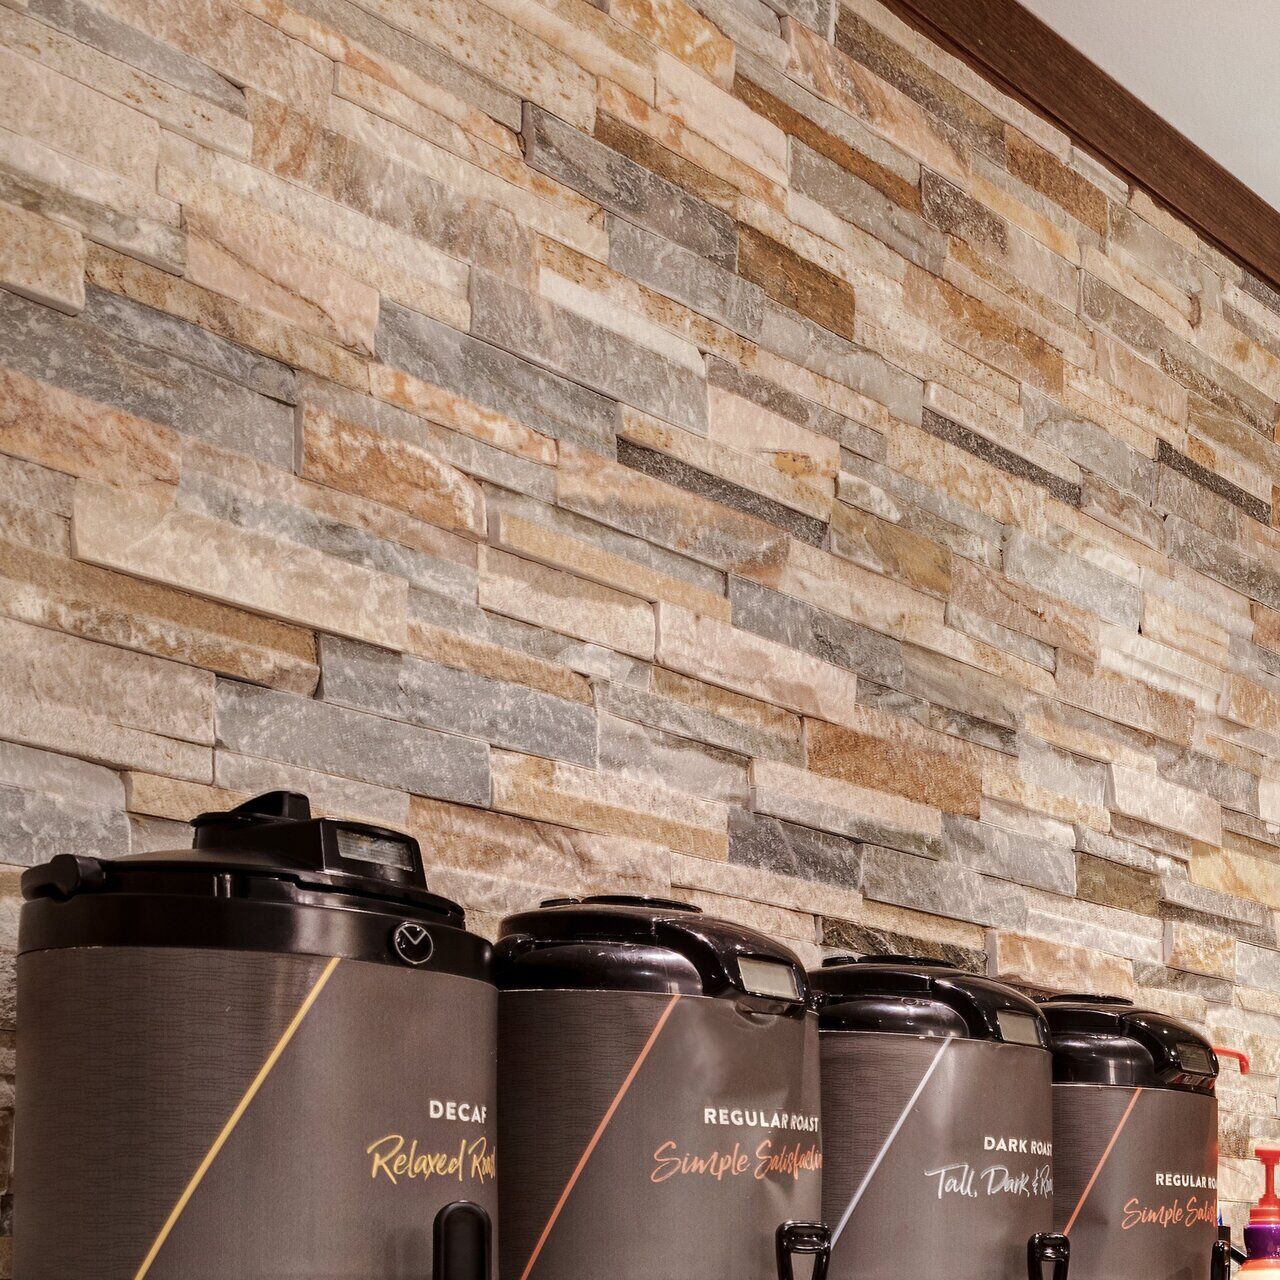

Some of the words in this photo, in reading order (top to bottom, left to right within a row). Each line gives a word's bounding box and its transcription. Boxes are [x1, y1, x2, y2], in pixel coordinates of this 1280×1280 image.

[429, 1100, 487, 1124] DECAF
[704, 1107, 789, 1130] REGULAR
[790, 1113, 819, 1132] ROAST
[366, 1134, 467, 1184] Relaxed
[984, 1136, 1028, 1154] DARK
[651, 1140, 750, 1183] Simple
[924, 1163, 978, 1199] Tall,
[980, 1165, 1030, 1198] Dark
[1155, 1173, 1206, 1189] REGULAR
[1121, 1198, 1184, 1229] Simple
